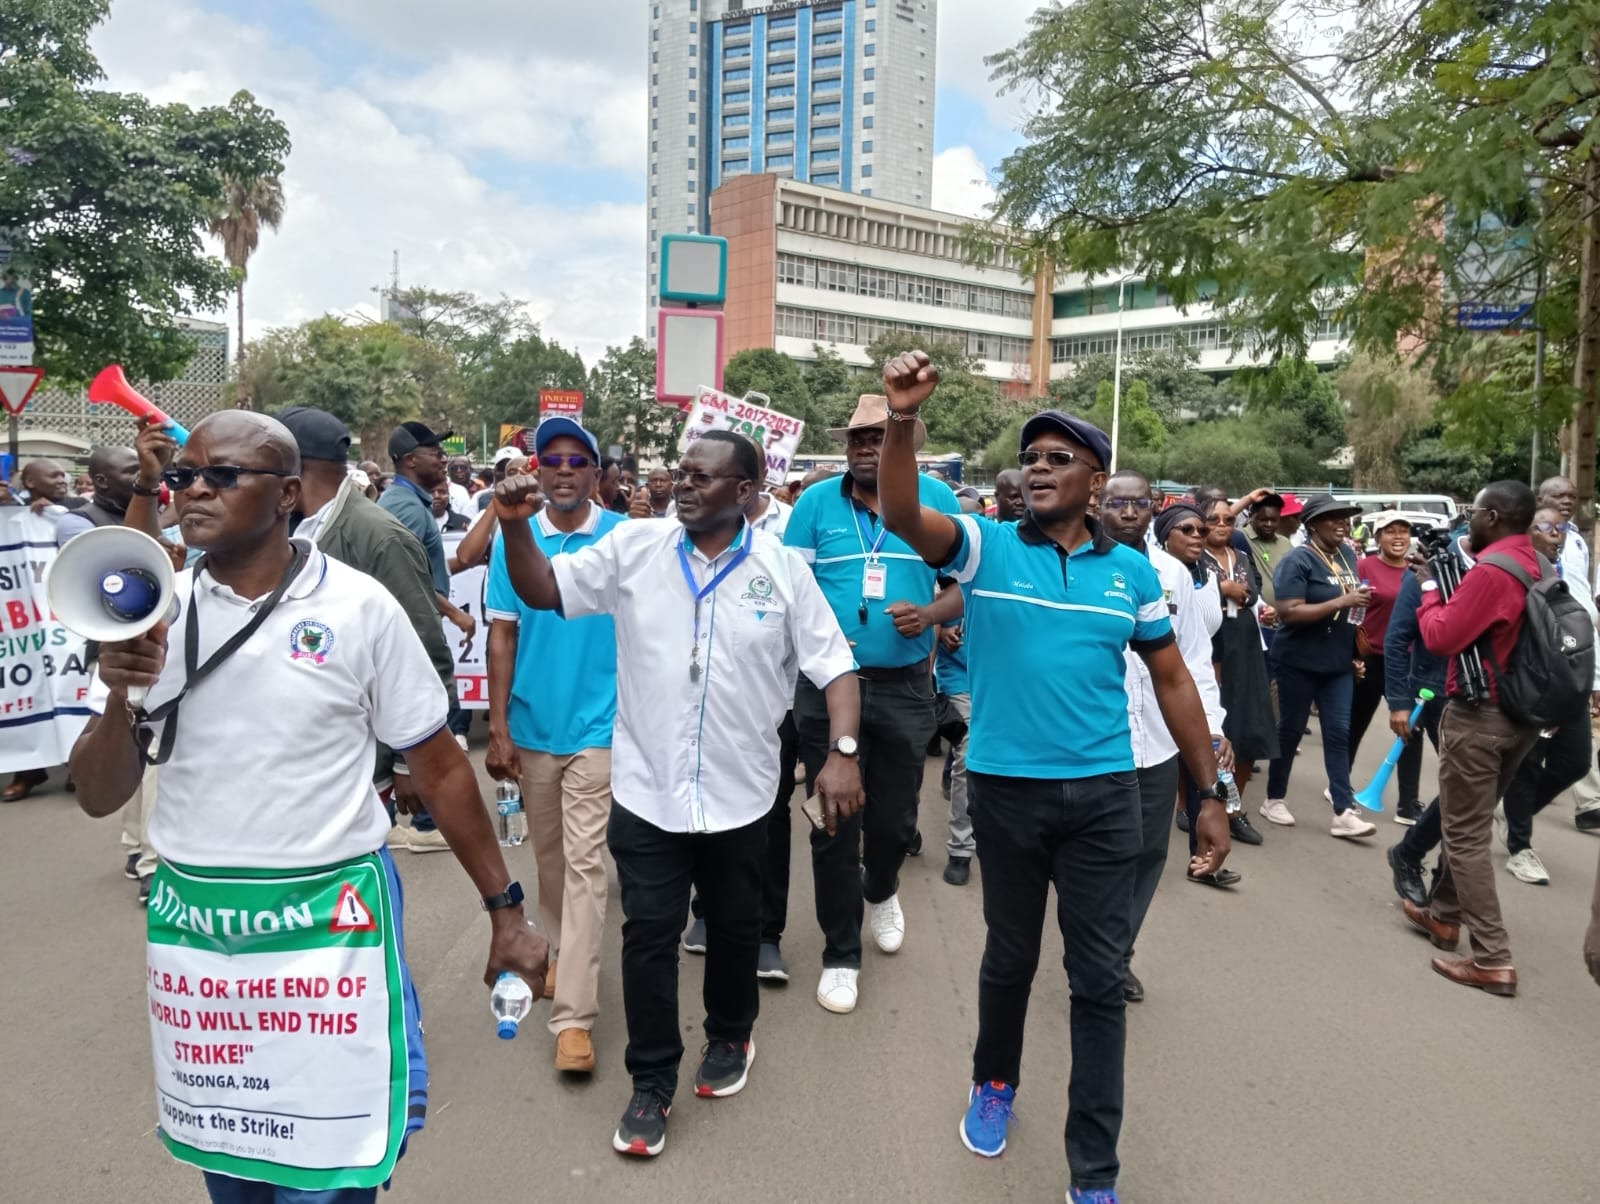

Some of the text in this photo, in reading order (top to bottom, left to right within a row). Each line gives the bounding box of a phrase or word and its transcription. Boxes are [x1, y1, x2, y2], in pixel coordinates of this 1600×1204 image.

[150, 880, 314, 937] ATTENTION
[152, 974, 194, 997] C.B.A.
[200, 977, 229, 998] OR
[236, 978, 276, 998] THE
[284, 977, 329, 998] END
[337, 976, 367, 998] OF
[150, 1001, 358, 1034] WORLD WILL END THIS
[174, 1040, 253, 1064] STRIKE!"
[243, 1076, 270, 1091] 2024
[162, 1097, 295, 1140] Support the Strike!
